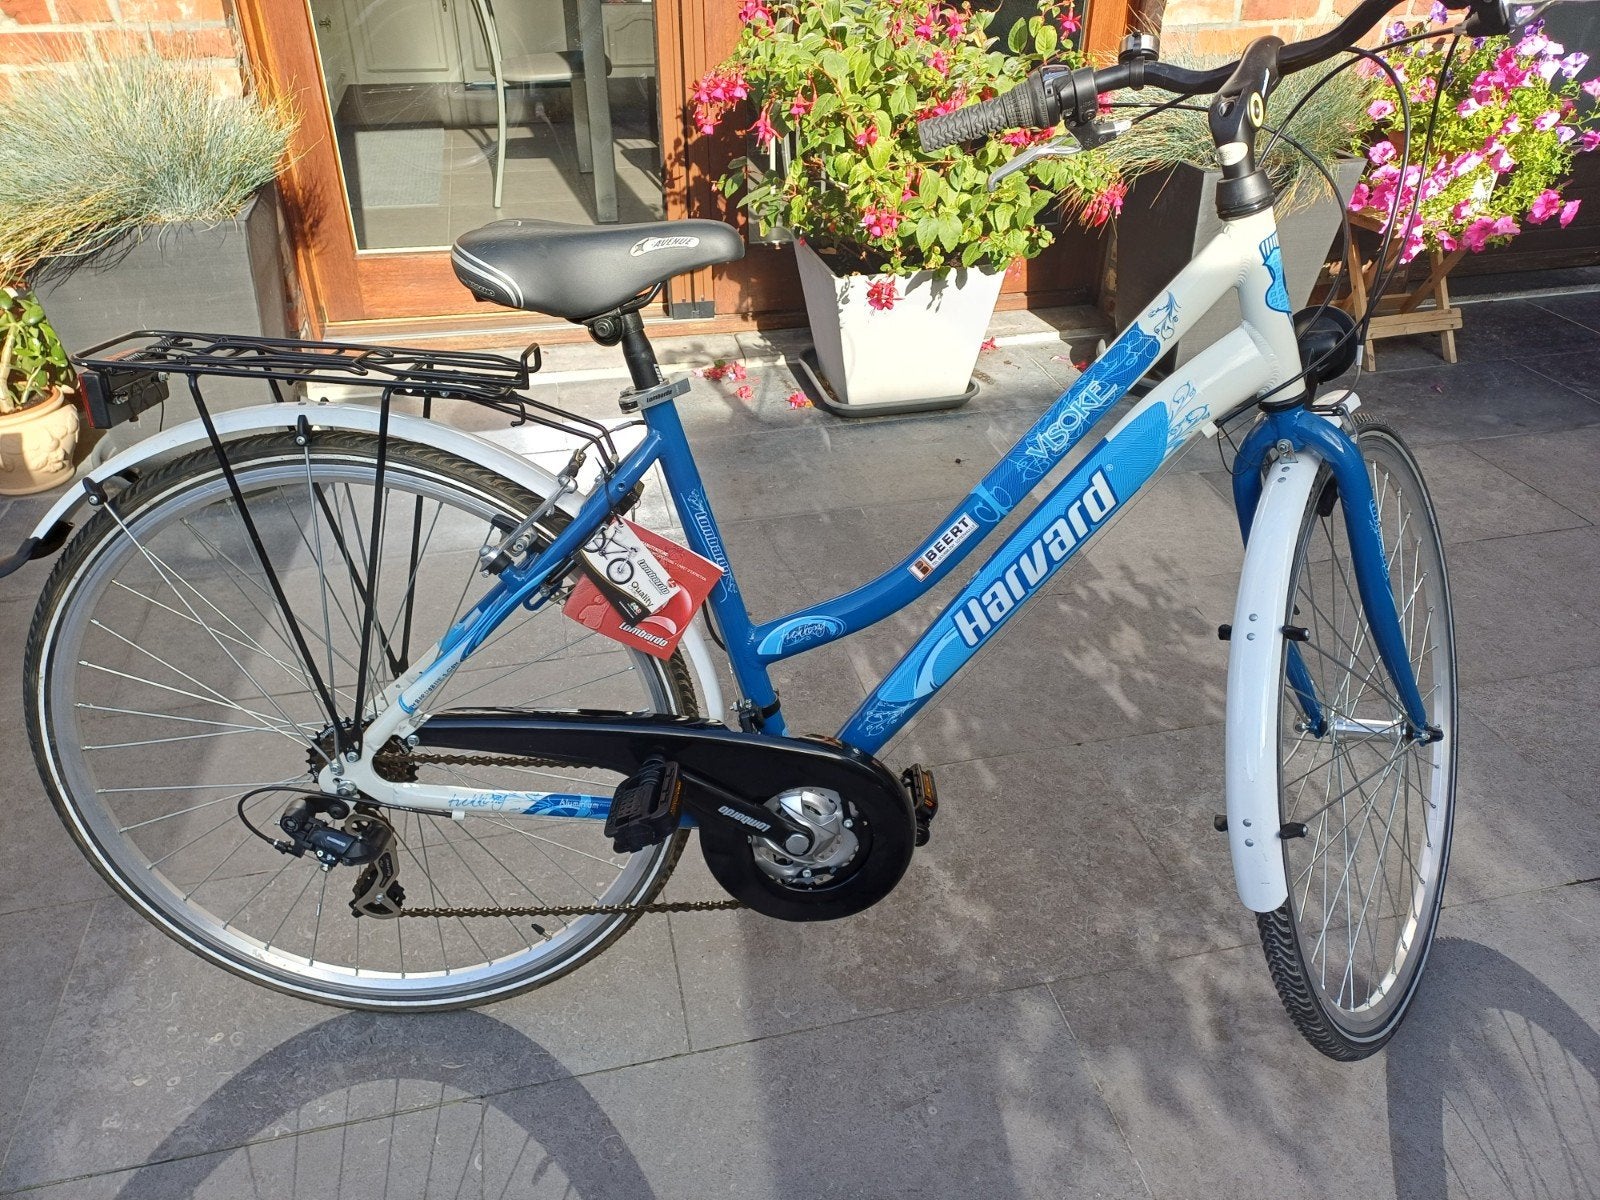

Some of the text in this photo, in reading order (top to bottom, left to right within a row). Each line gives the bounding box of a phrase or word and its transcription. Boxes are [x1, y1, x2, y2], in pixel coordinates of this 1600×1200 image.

[925, 516, 969, 562] BEERT
[953, 469, 1118, 647] Harvard
[631, 581, 654, 607] Quality
